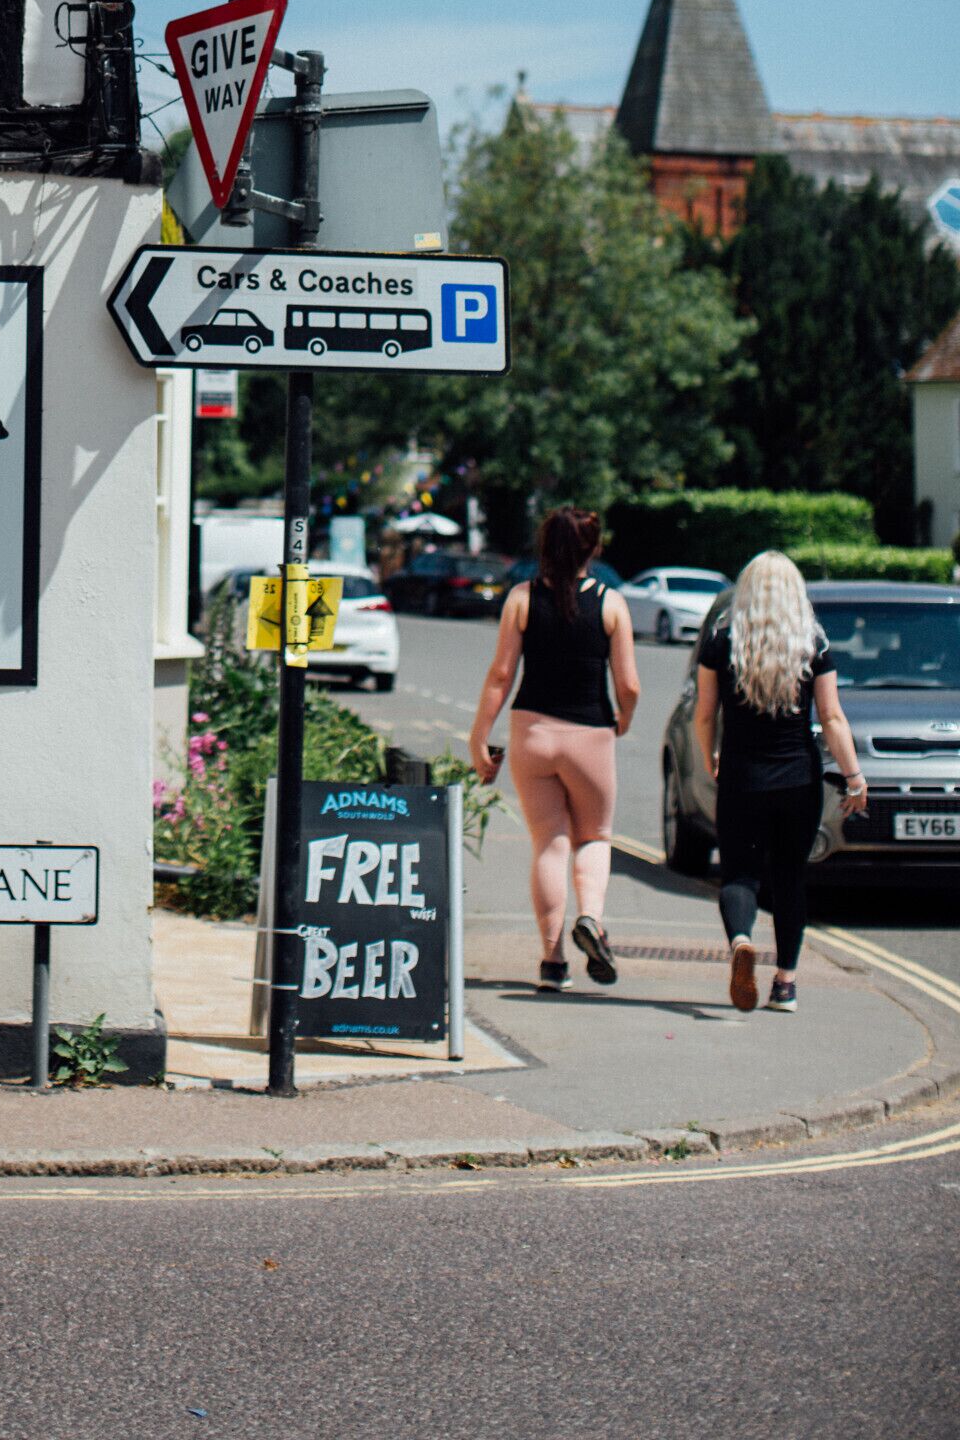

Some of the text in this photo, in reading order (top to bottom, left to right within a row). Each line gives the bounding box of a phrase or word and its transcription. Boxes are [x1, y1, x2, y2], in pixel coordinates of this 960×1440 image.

[191, 25, 256, 79] GIVE
[205, 79, 246, 114] WAY
[196, 265, 414, 295] Cars & Coaches
[455, 290, 489, 337] P
[320, 790, 409, 816] ADNAMS
[337, 812, 396, 821] SOUTHWOLD
[905, 818, 956, 836] EY66
[305, 834, 426, 907] FREE
[299, 937, 420, 1000] BEER
